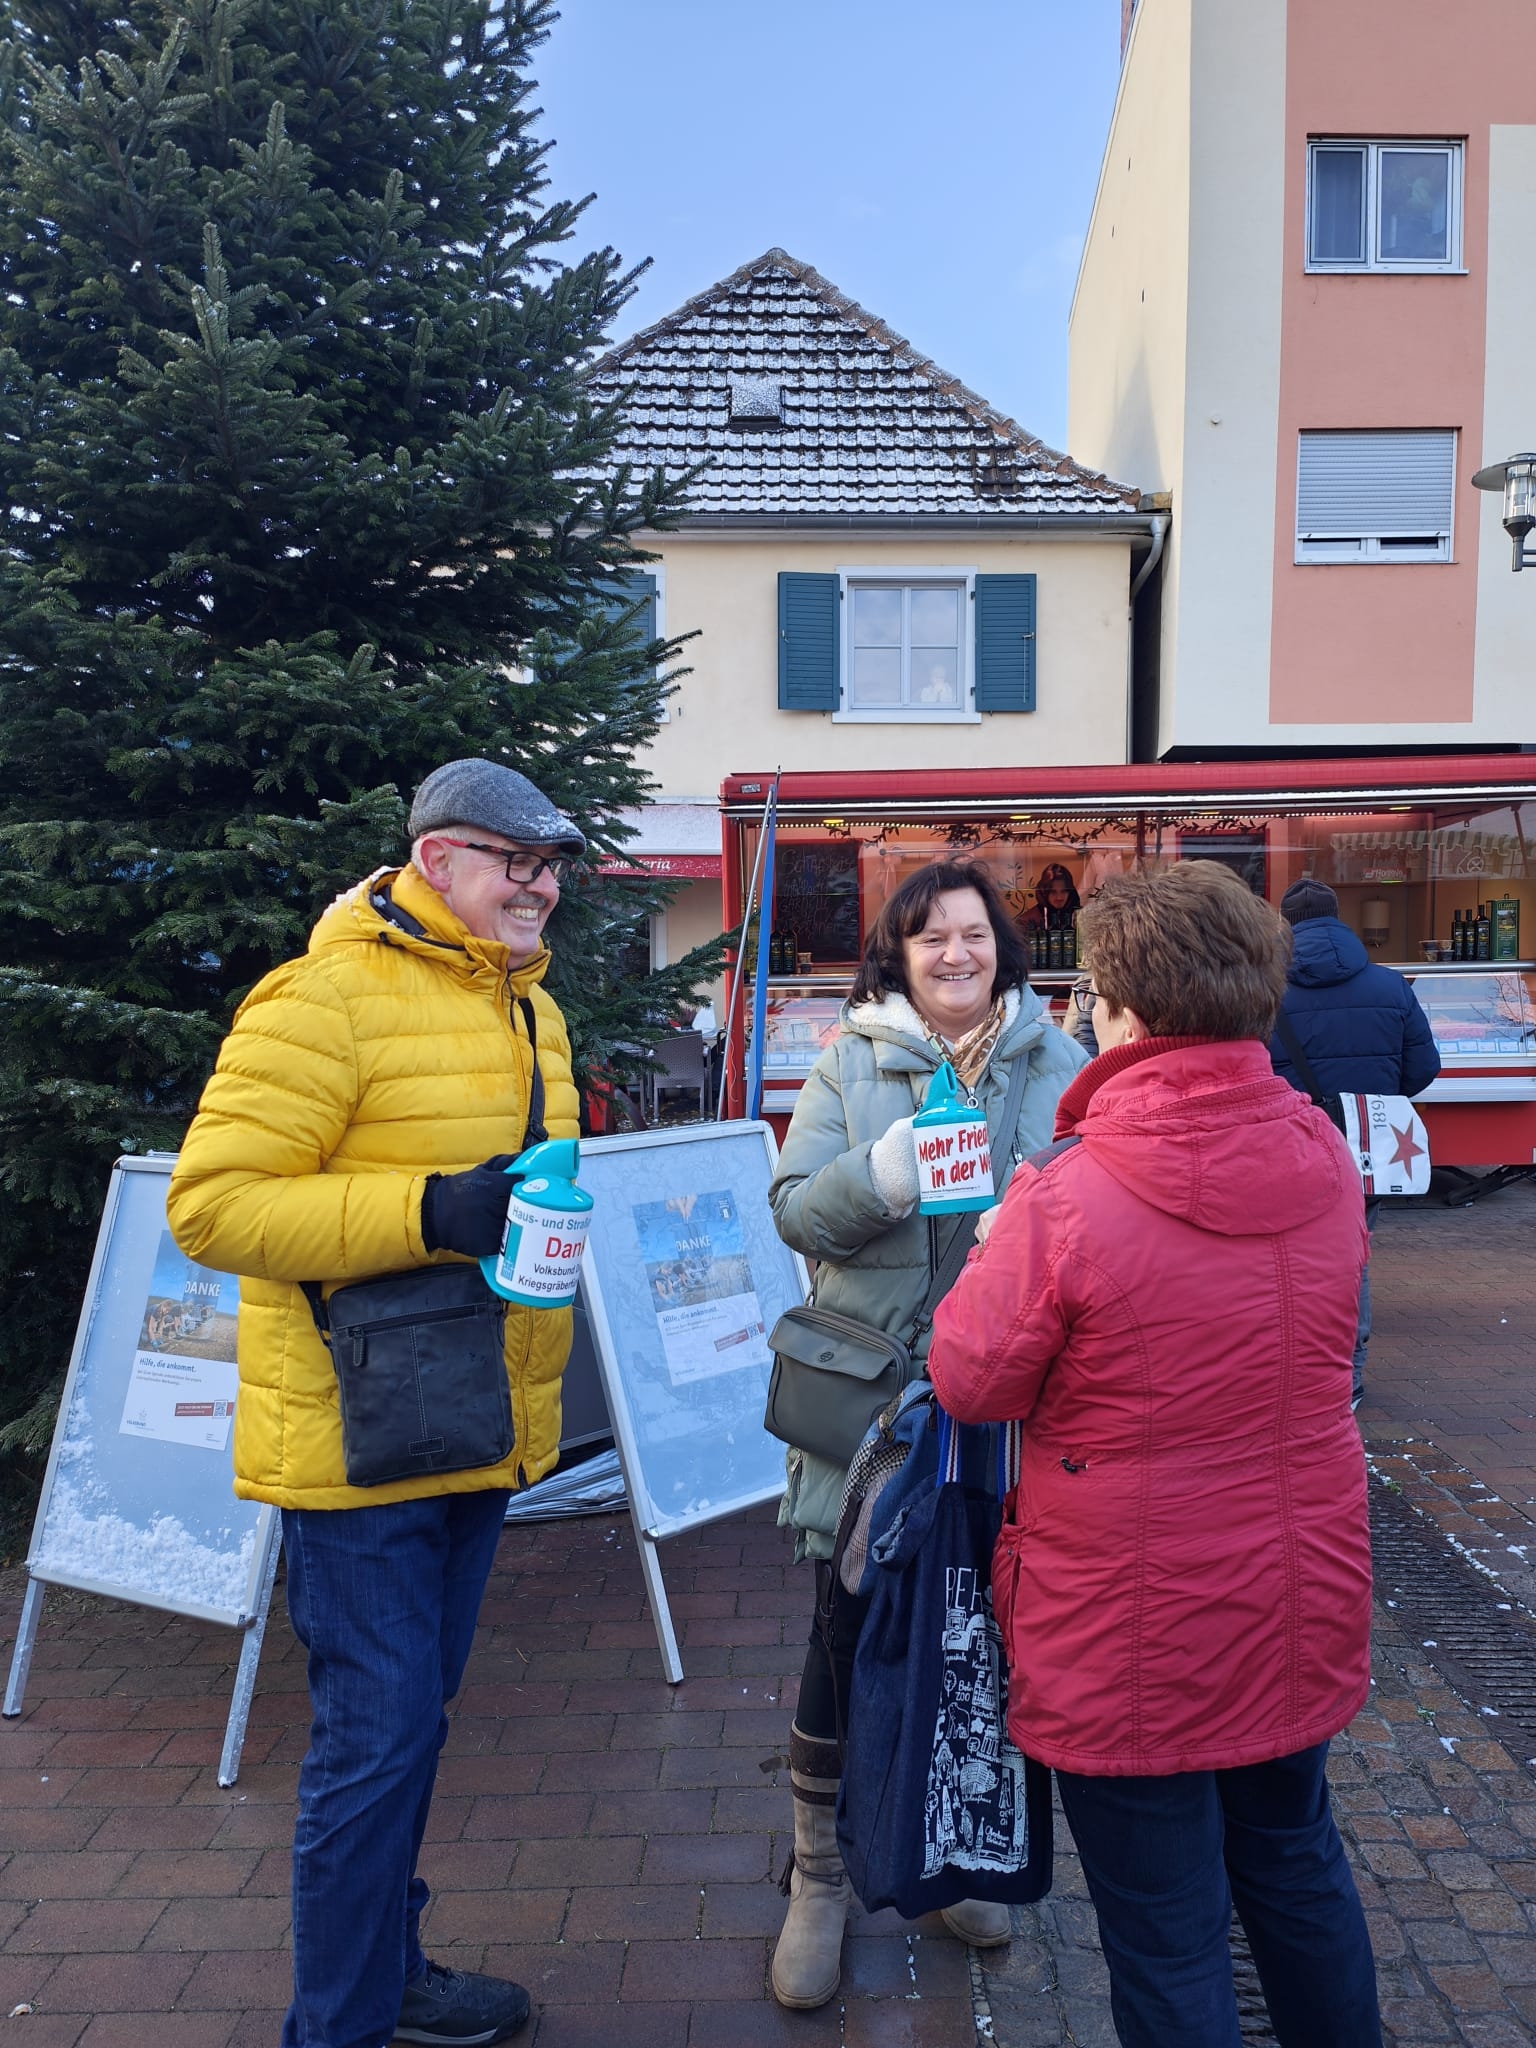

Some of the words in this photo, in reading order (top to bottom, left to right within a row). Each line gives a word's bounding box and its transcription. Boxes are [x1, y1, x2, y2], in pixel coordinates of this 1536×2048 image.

[919, 1136, 954, 1164] Mehr
[930, 1165, 946, 1188] in
[950, 1159, 976, 1183] der
[512, 1204, 539, 1224] Haus-
[542, 1218, 565, 1230] und
[675, 1234, 712, 1252] DANKE
[534, 1263, 575, 1276] Volksbund
[184, 1280, 221, 1297] DANKE
[139, 1357, 156, 1369] Hilfe,
[157, 1359, 166, 1369] die
[166, 1361, 198, 1373] ankommt.
